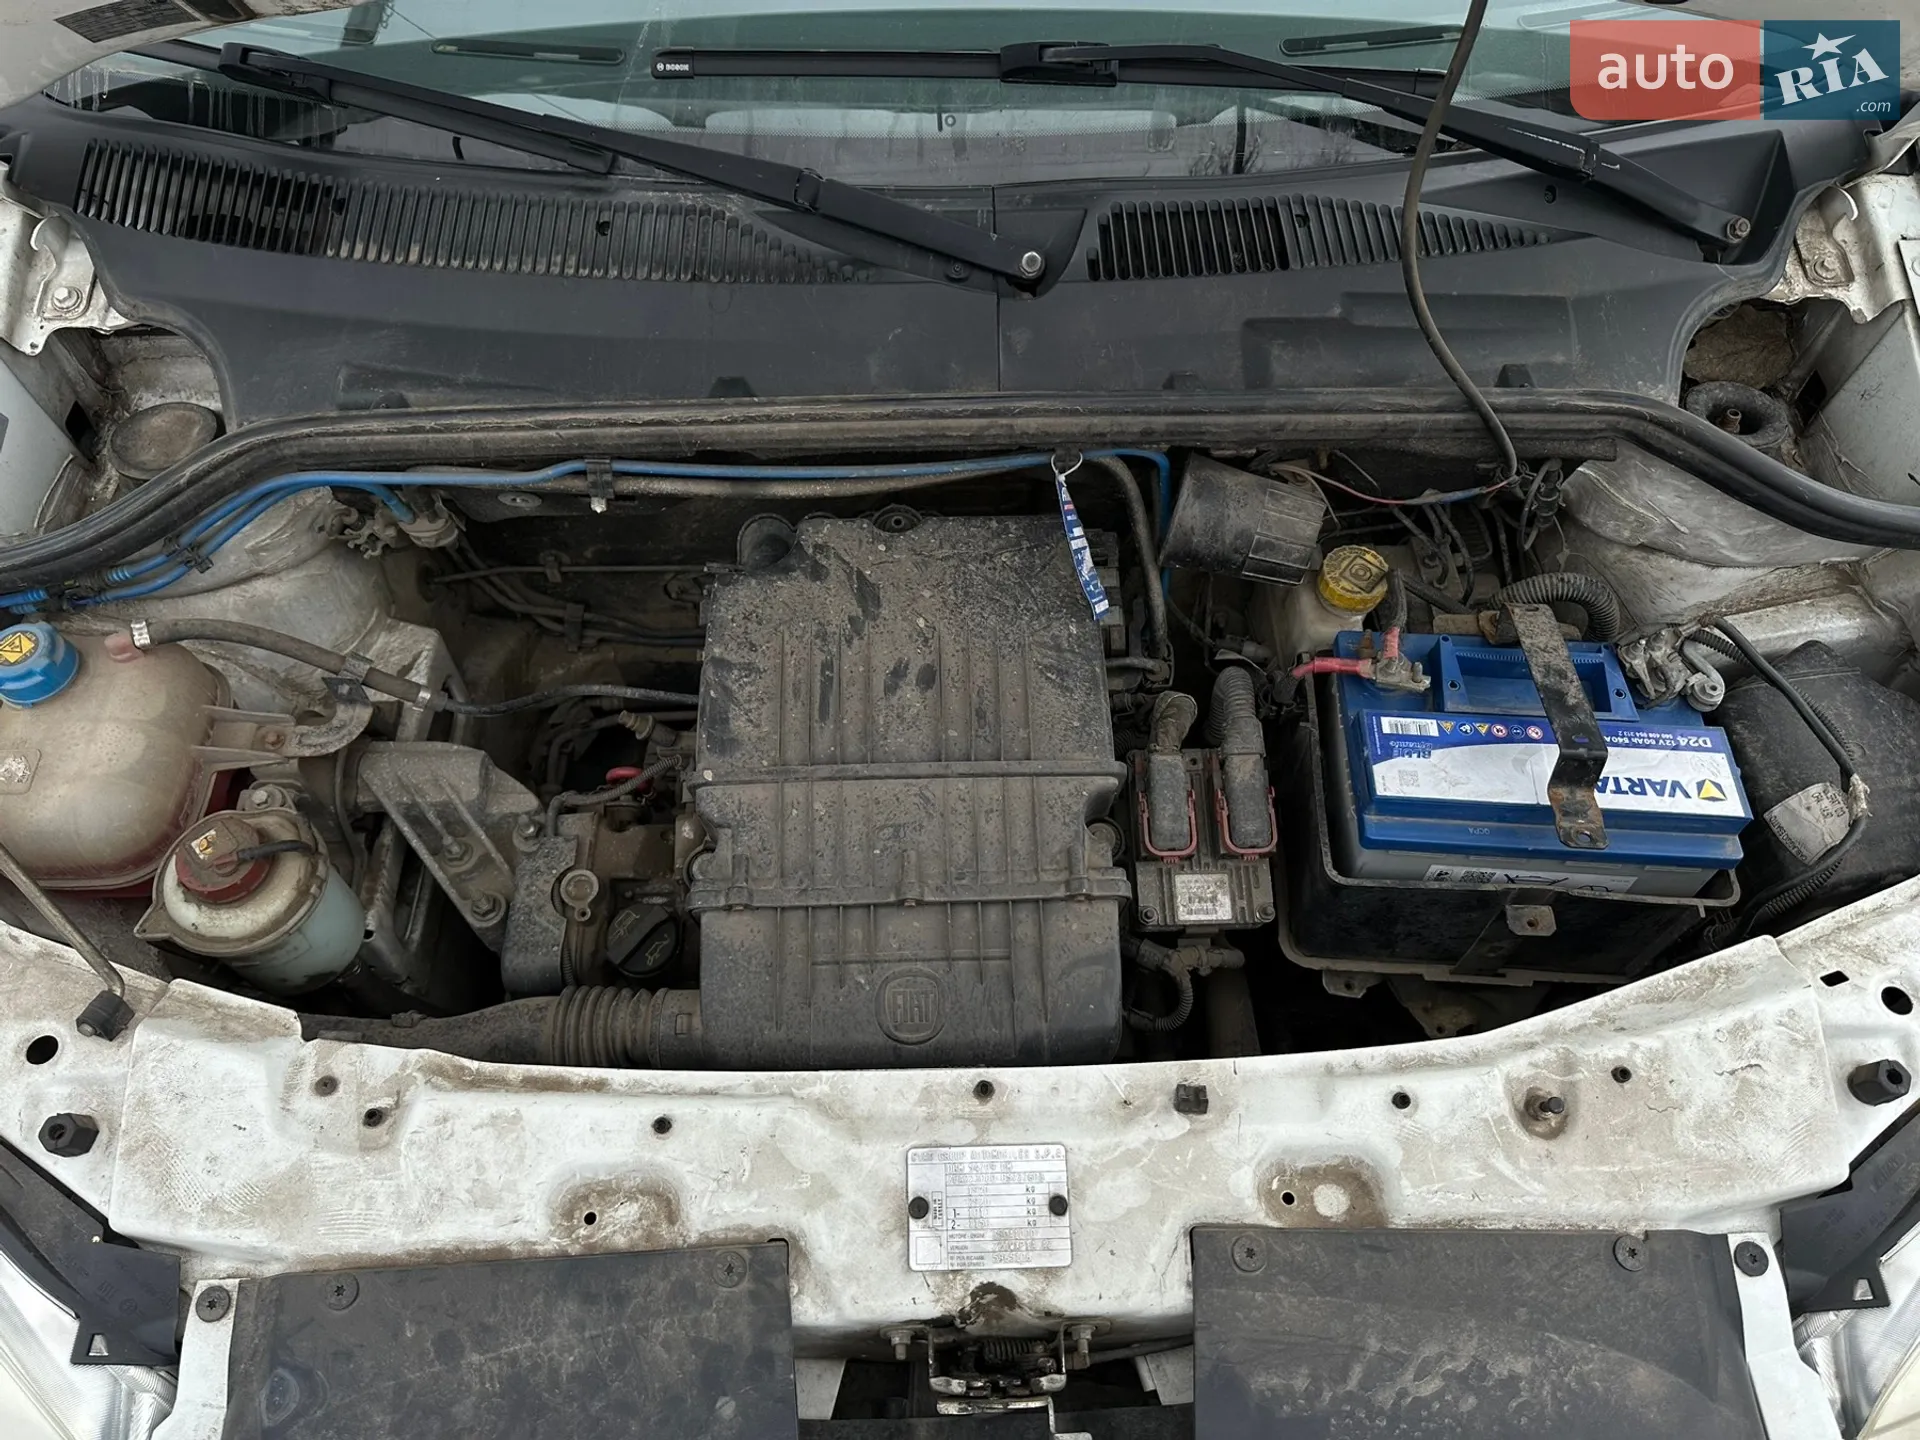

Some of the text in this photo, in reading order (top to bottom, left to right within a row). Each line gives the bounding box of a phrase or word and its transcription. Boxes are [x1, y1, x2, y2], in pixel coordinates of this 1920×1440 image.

[1658, 739, 1677, 747] 12V
[1676, 735, 1713, 748] D24
[1393, 747, 1432, 759] BLUE
[1594, 776, 1692, 799] VARTA
[890, 988, 935, 1024] FIAT
